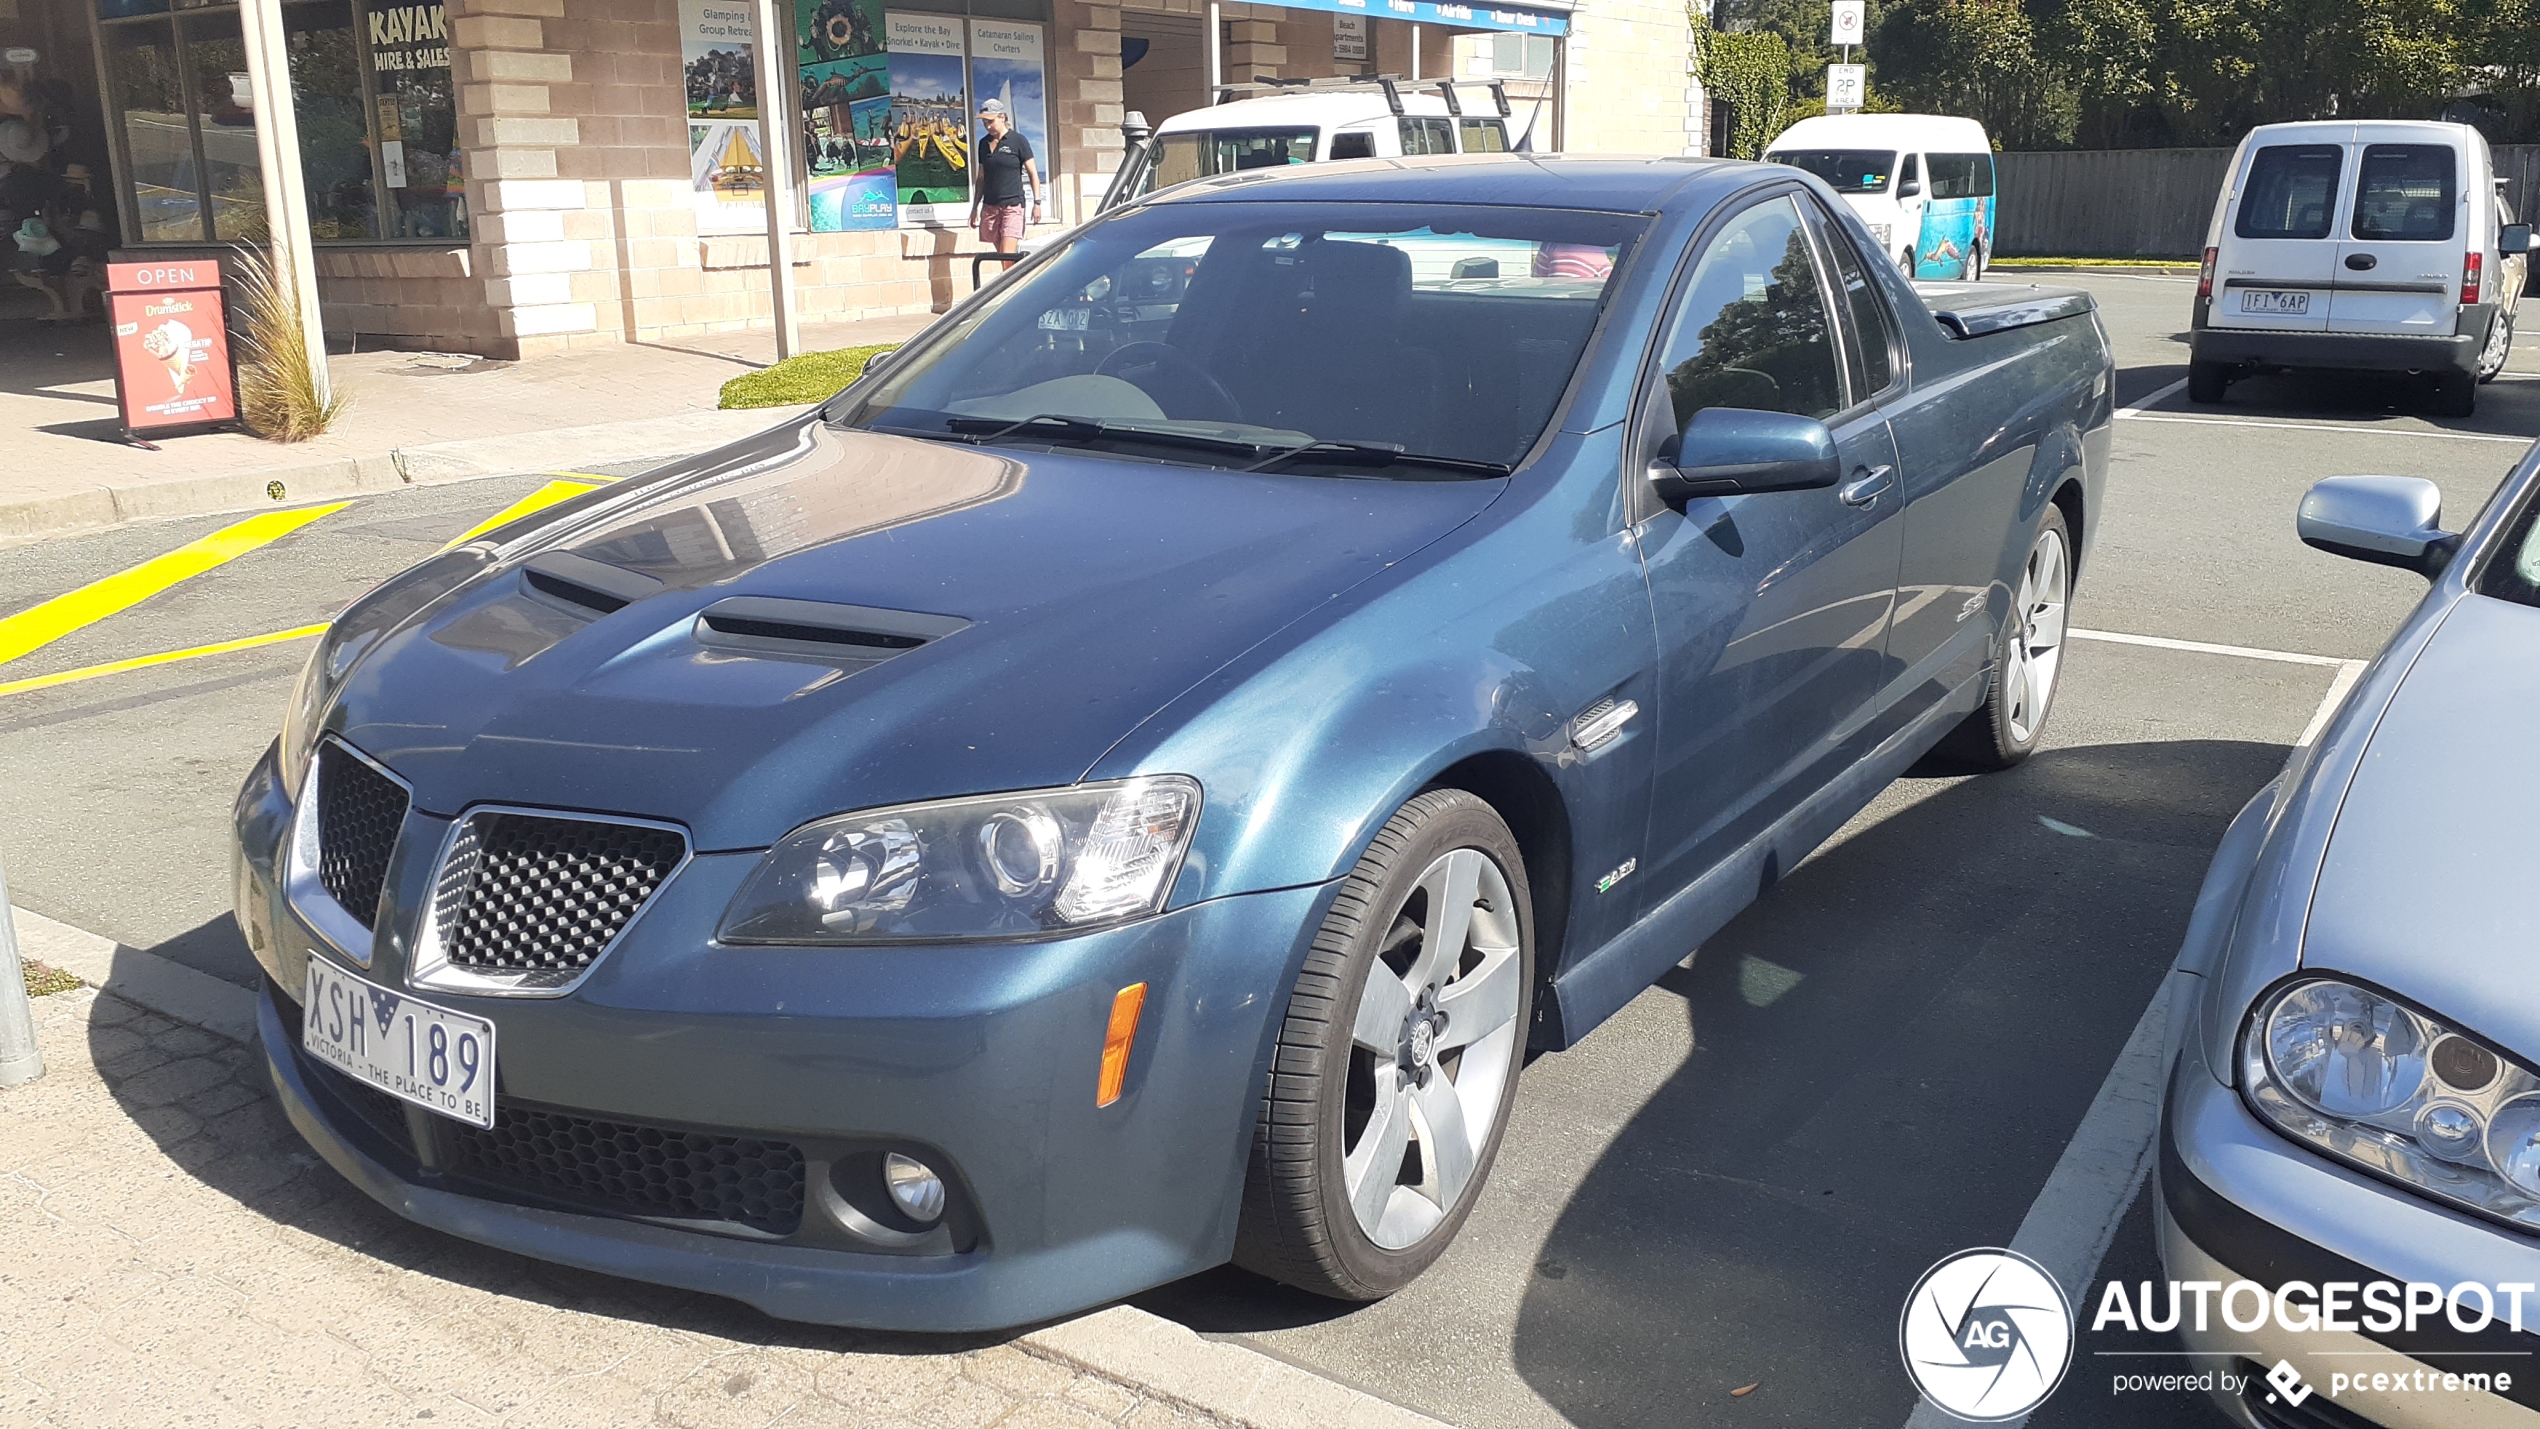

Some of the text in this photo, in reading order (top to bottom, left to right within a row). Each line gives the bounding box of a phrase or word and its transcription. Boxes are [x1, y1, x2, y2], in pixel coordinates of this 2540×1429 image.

[703, 9, 745, 23] Glamping
[1393, 0, 1416, 14] Hire
[1441, 4, 1473, 20] Airfills
[1496, 10, 1516, 24] Tour
[1516, 13, 1538, 27] Desk
[369, 5, 448, 45] KAYAK
[699, 24, 726, 36] Group
[895, 23, 951, 36] Explore the Bay
[1339, 20, 1355, 30] Beach
[978, 28, 1034, 43] Catamaran Sailing
[887, 36, 960, 50] Snorkel Kayak Dive
[993, 43, 1021, 54] Charters
[374, 47, 450, 71] HIRE & SALES
[1837, 79, 1856, 93] 2P
[852, 203, 893, 213] BAYPLAY
[137, 268, 195, 285] OPEN
[2247, 294, 2306, 309] 1FI 6AP
[145, 301, 193, 317] Drumstick
[119, 326, 134, 334] NEW
[309, 968, 480, 1093] XSH 189
[310, 1032, 354, 1069] VICTORIA
[368, 1063, 389, 1085] THE
[395, 1077, 433, 1101] PLACE
[440, 1091, 457, 1109] TO
[465, 1099, 481, 1118] BE
